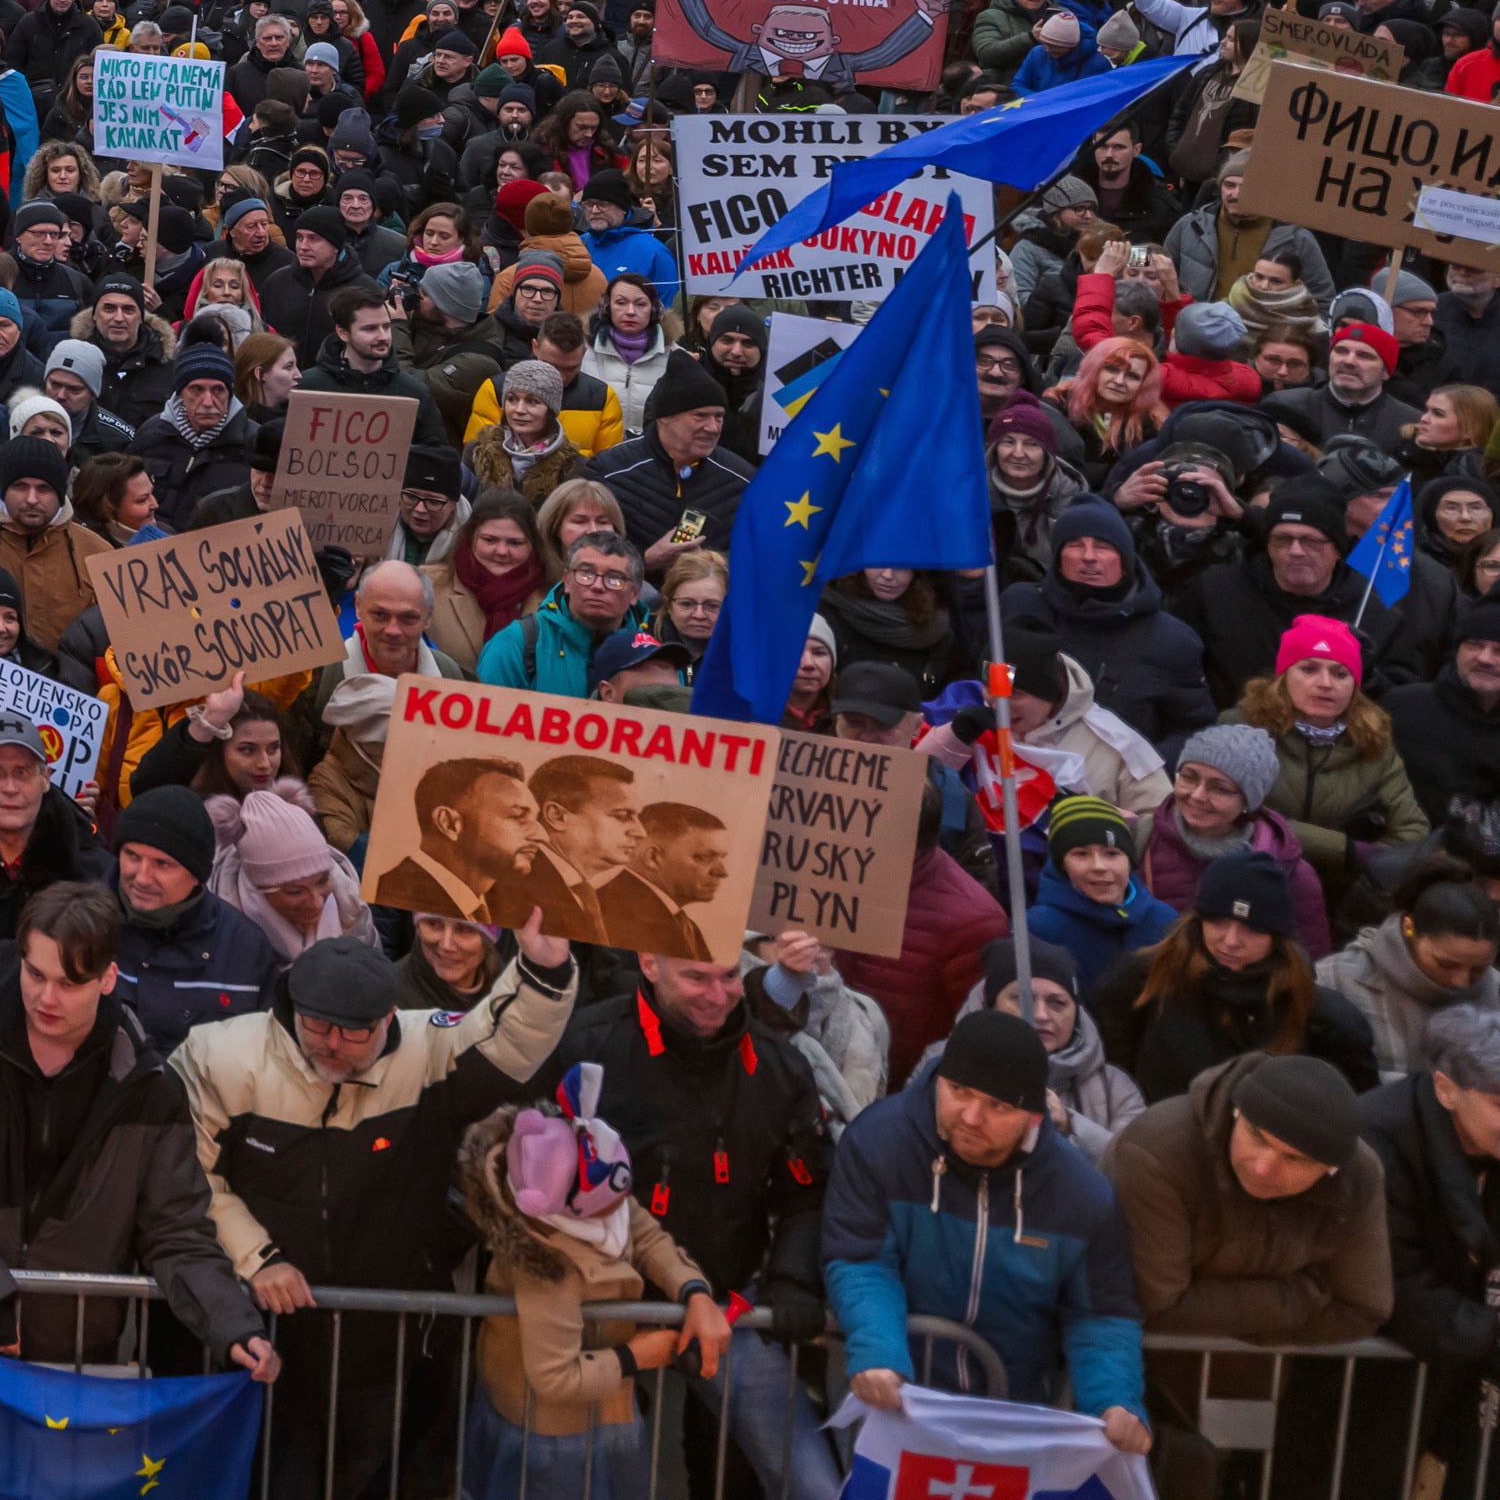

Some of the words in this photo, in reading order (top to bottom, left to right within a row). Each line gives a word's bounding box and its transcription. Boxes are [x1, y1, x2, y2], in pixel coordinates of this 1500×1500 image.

[100, 58, 140, 79] NIKTO
[165, 83, 215, 111] PUTIN
[709, 119, 864, 145] MOHLI
[701, 154, 798, 178] SEM
[761, 262, 883, 299] RICHTER
[310, 406, 390, 444] FICO
[283, 488, 389, 514] MIEROTVORCA
[103, 548, 198, 618] VRAJ
[403, 686, 767, 777] KOLABORANTI
[762, 830, 877, 886] RUSKÝ
[769, 881, 860, 934] PLYN
